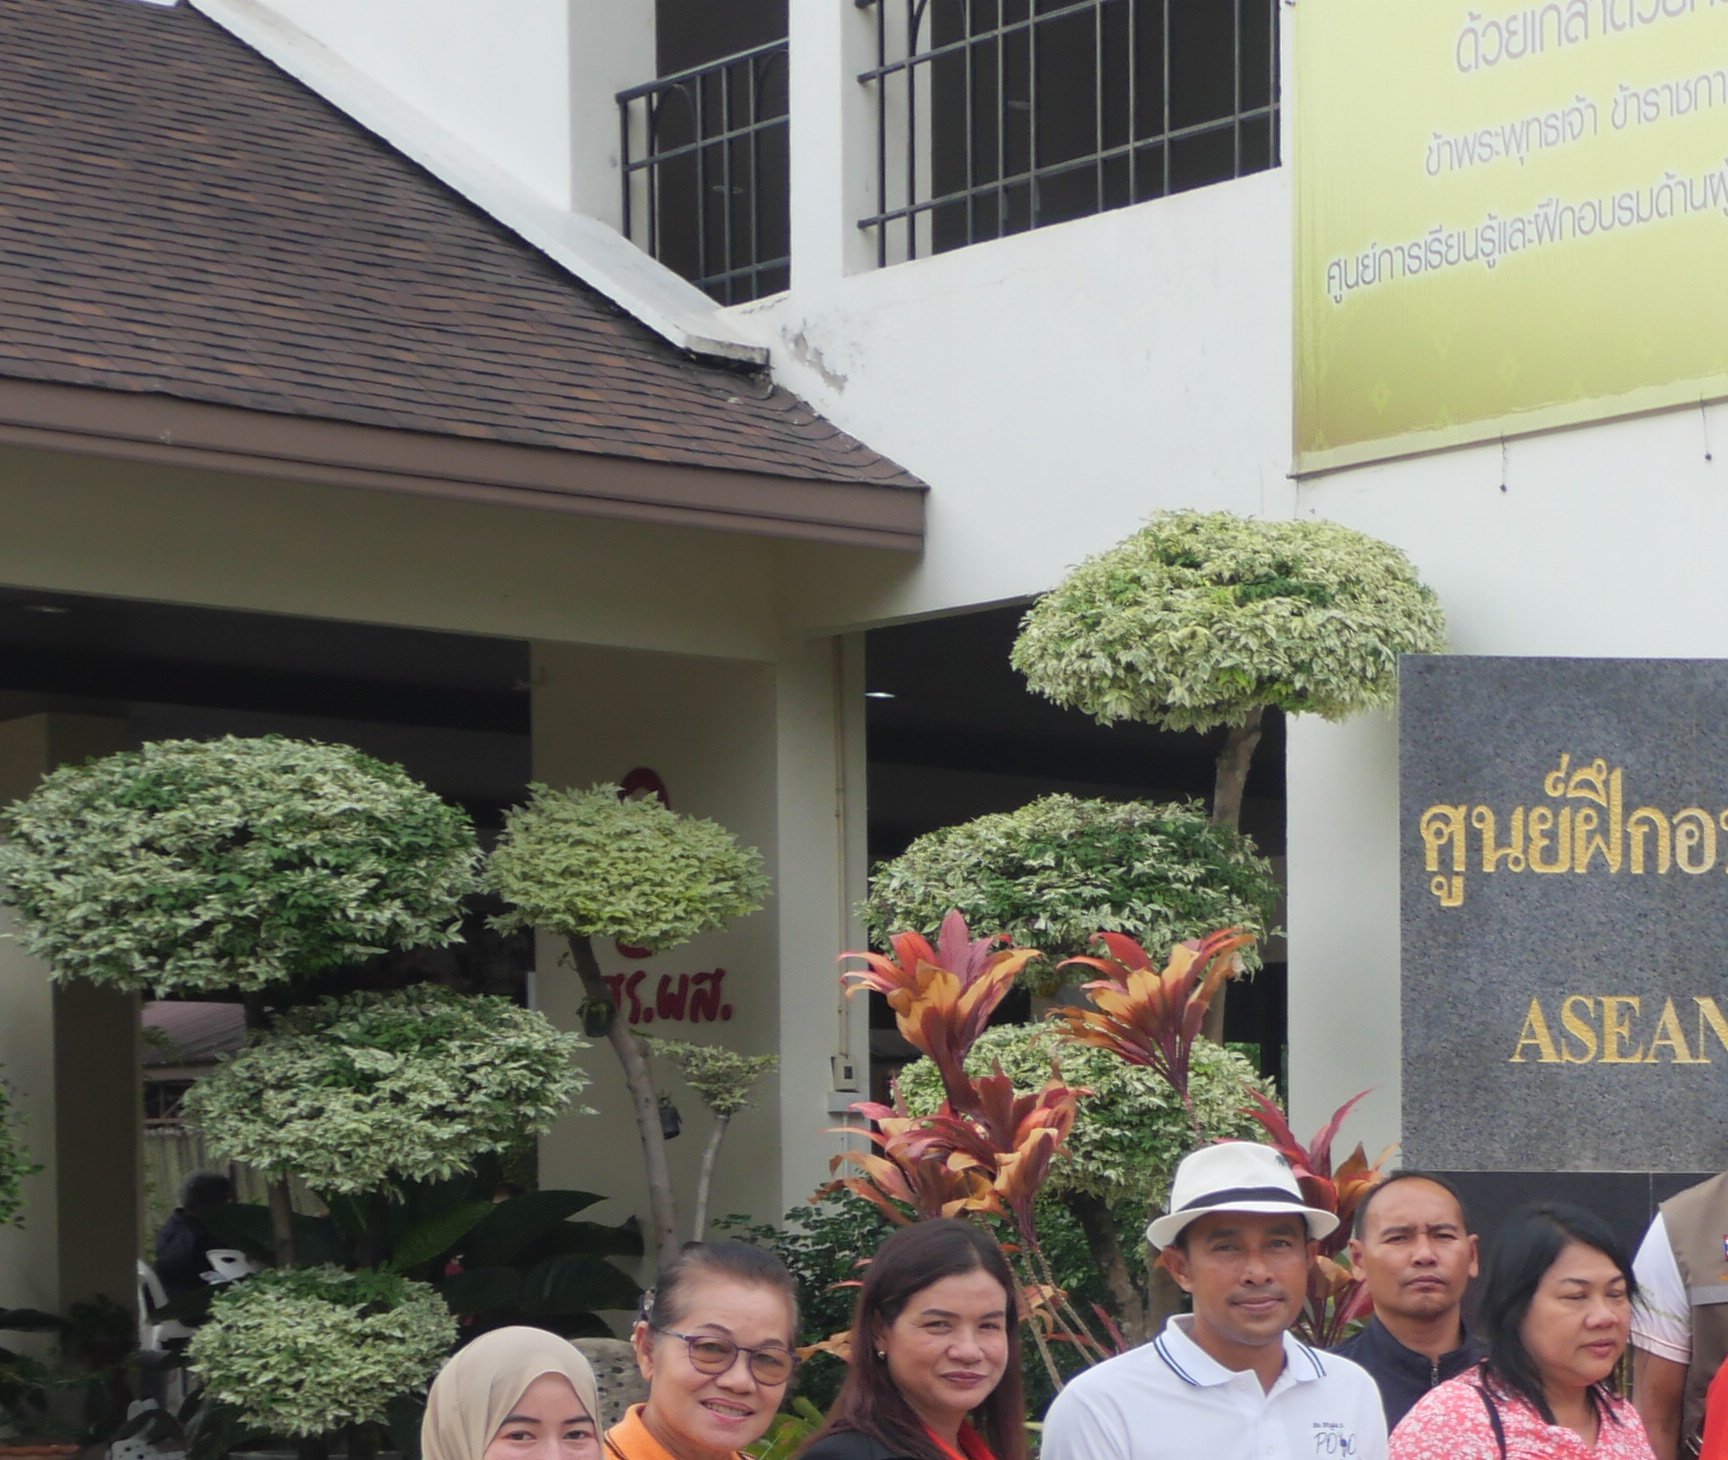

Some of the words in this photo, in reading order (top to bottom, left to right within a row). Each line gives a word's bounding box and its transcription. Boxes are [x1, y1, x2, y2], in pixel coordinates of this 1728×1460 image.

[1425, 96, 1598, 176] ข้าพระพุทธเจ้า
